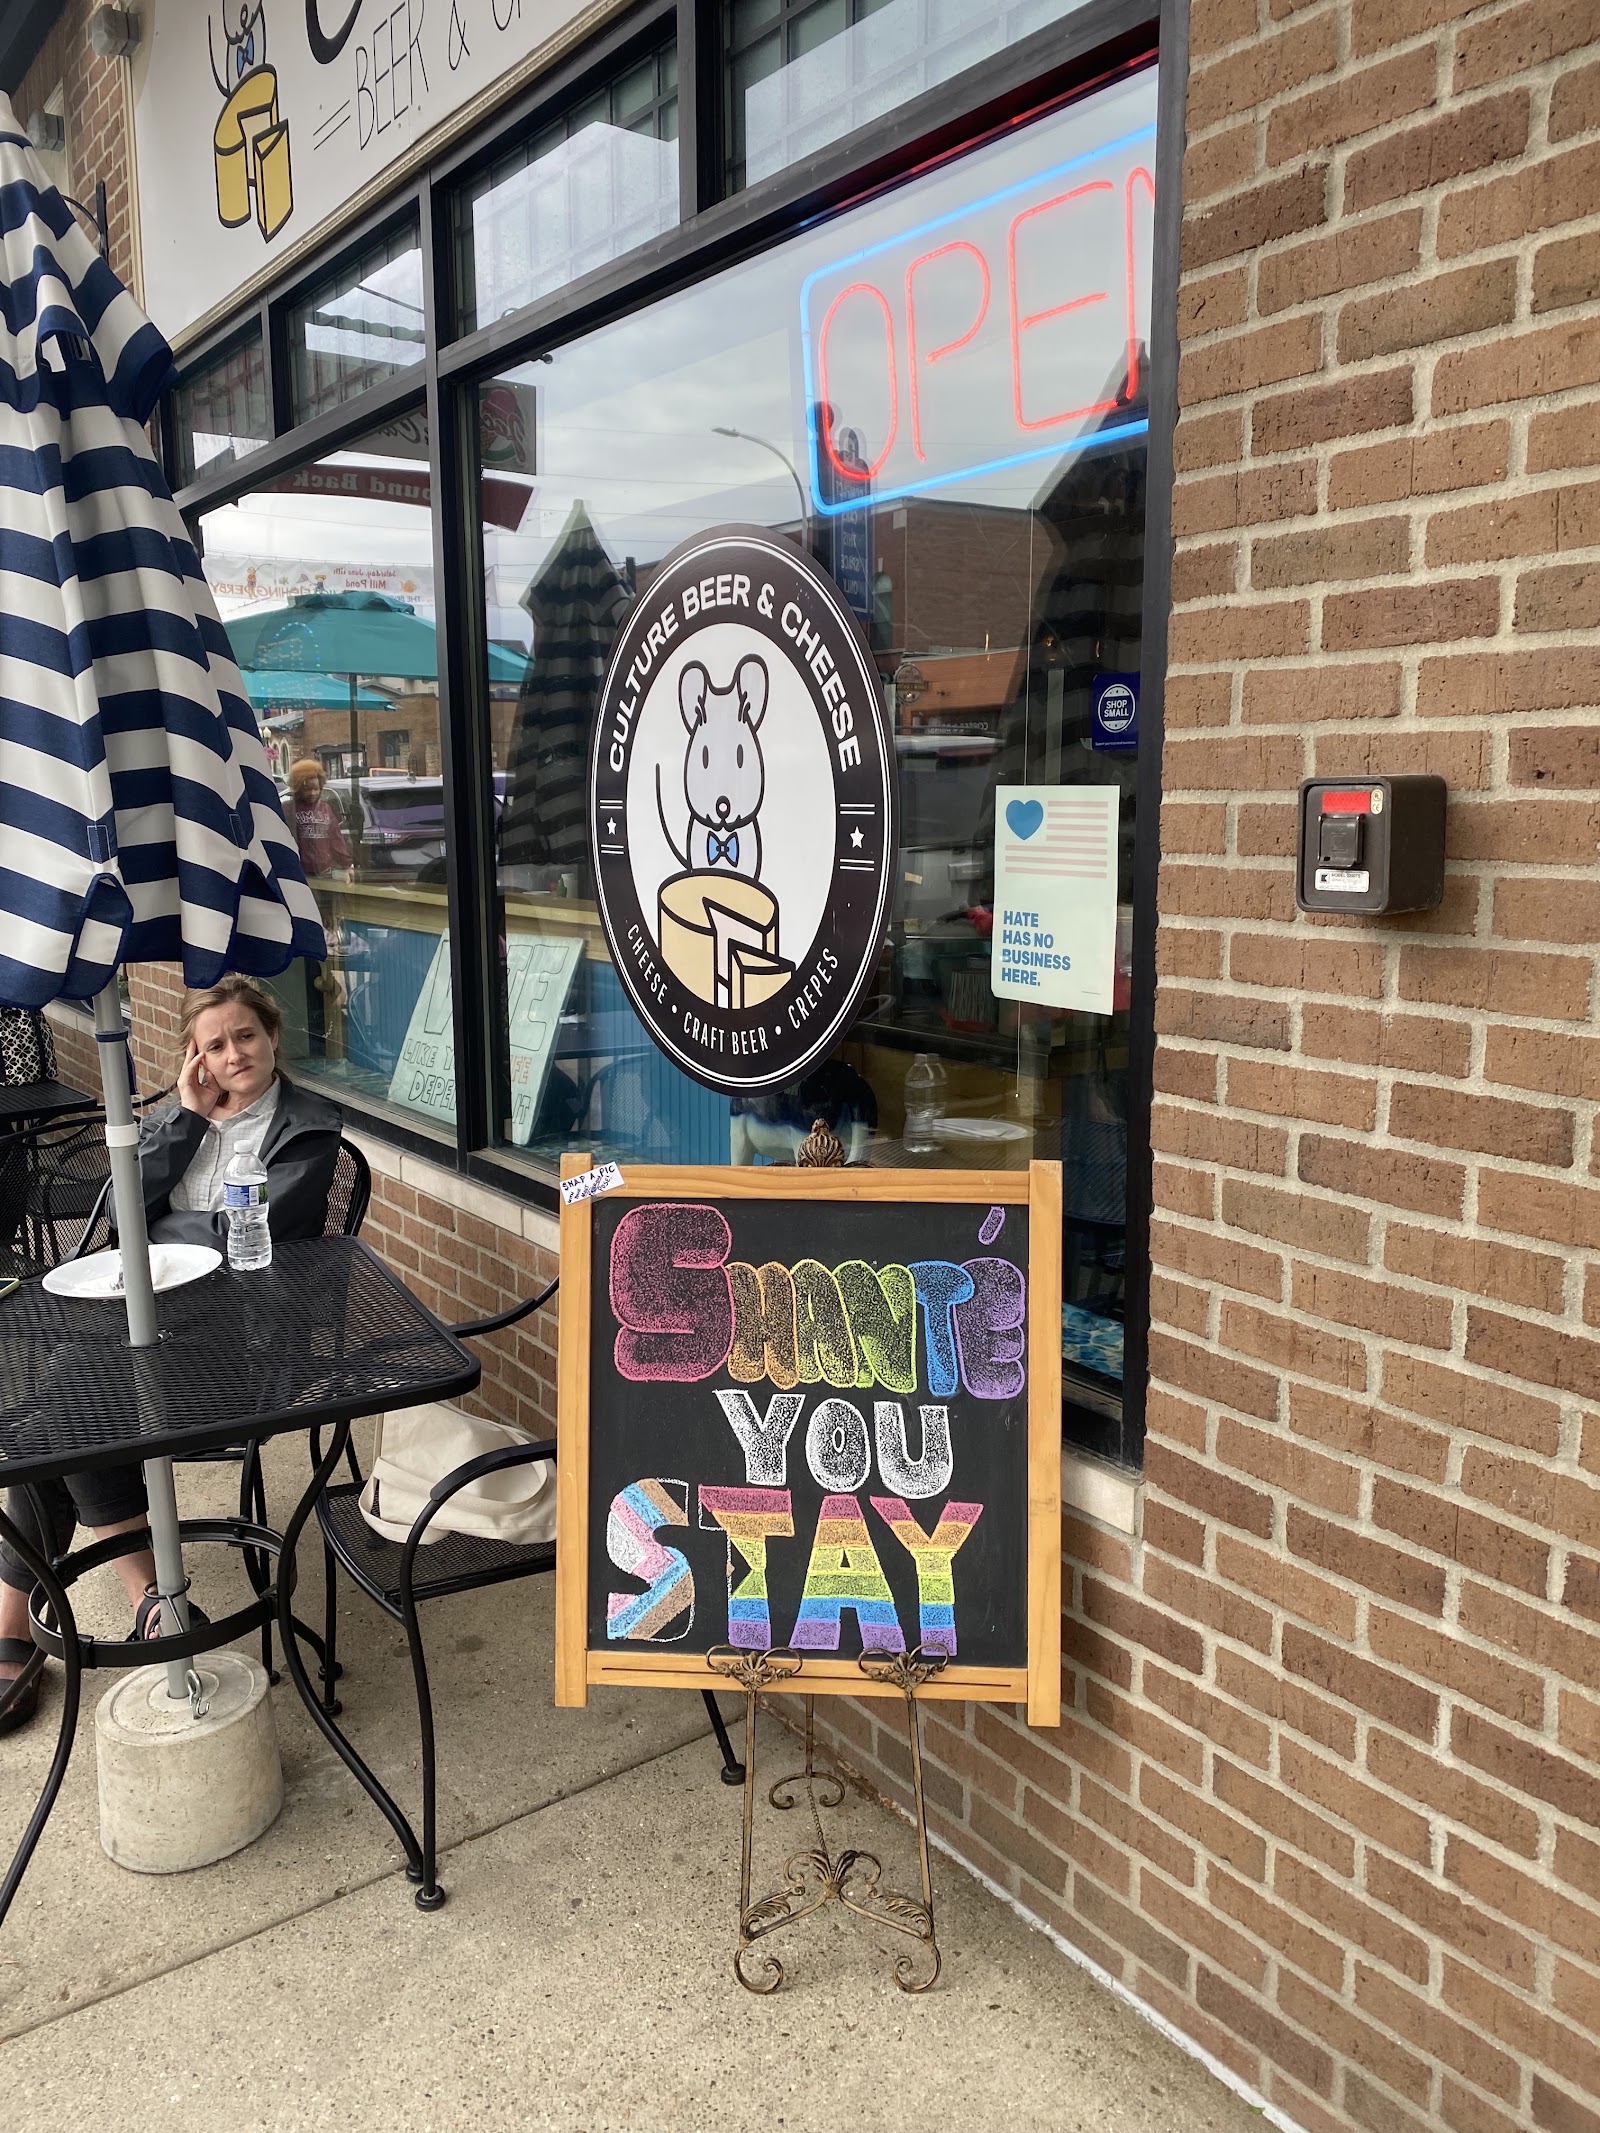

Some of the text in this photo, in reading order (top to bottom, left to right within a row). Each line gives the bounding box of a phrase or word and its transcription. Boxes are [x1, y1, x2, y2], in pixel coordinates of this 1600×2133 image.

[355, 0, 429, 151] BEER
[609, 573, 862, 773] CULTURE BEER & CHEESE
[1104, 708, 1129, 718] SMALL
[1106, 700, 1128, 709] SHOP
[1003, 910, 1039, 928] HATE
[1002, 929, 1054, 949] HAS NO
[1002, 948, 1071, 971] BUSINESS
[627, 923, 840, 1056] CHEESE CRAFT BEER CREPES
[1001, 967, 1041, 987] HERE.
[403, 1038, 439, 1068] LIKE
[408, 1070, 456, 1111] DEPE
[562, 1175, 586, 1191] SNAP
[590, 1172, 596, 1180] A
[599, 1164, 615, 1177] PIC
[714, 1388, 954, 1500] YOU
[606, 1477, 985, 1657] STAY
